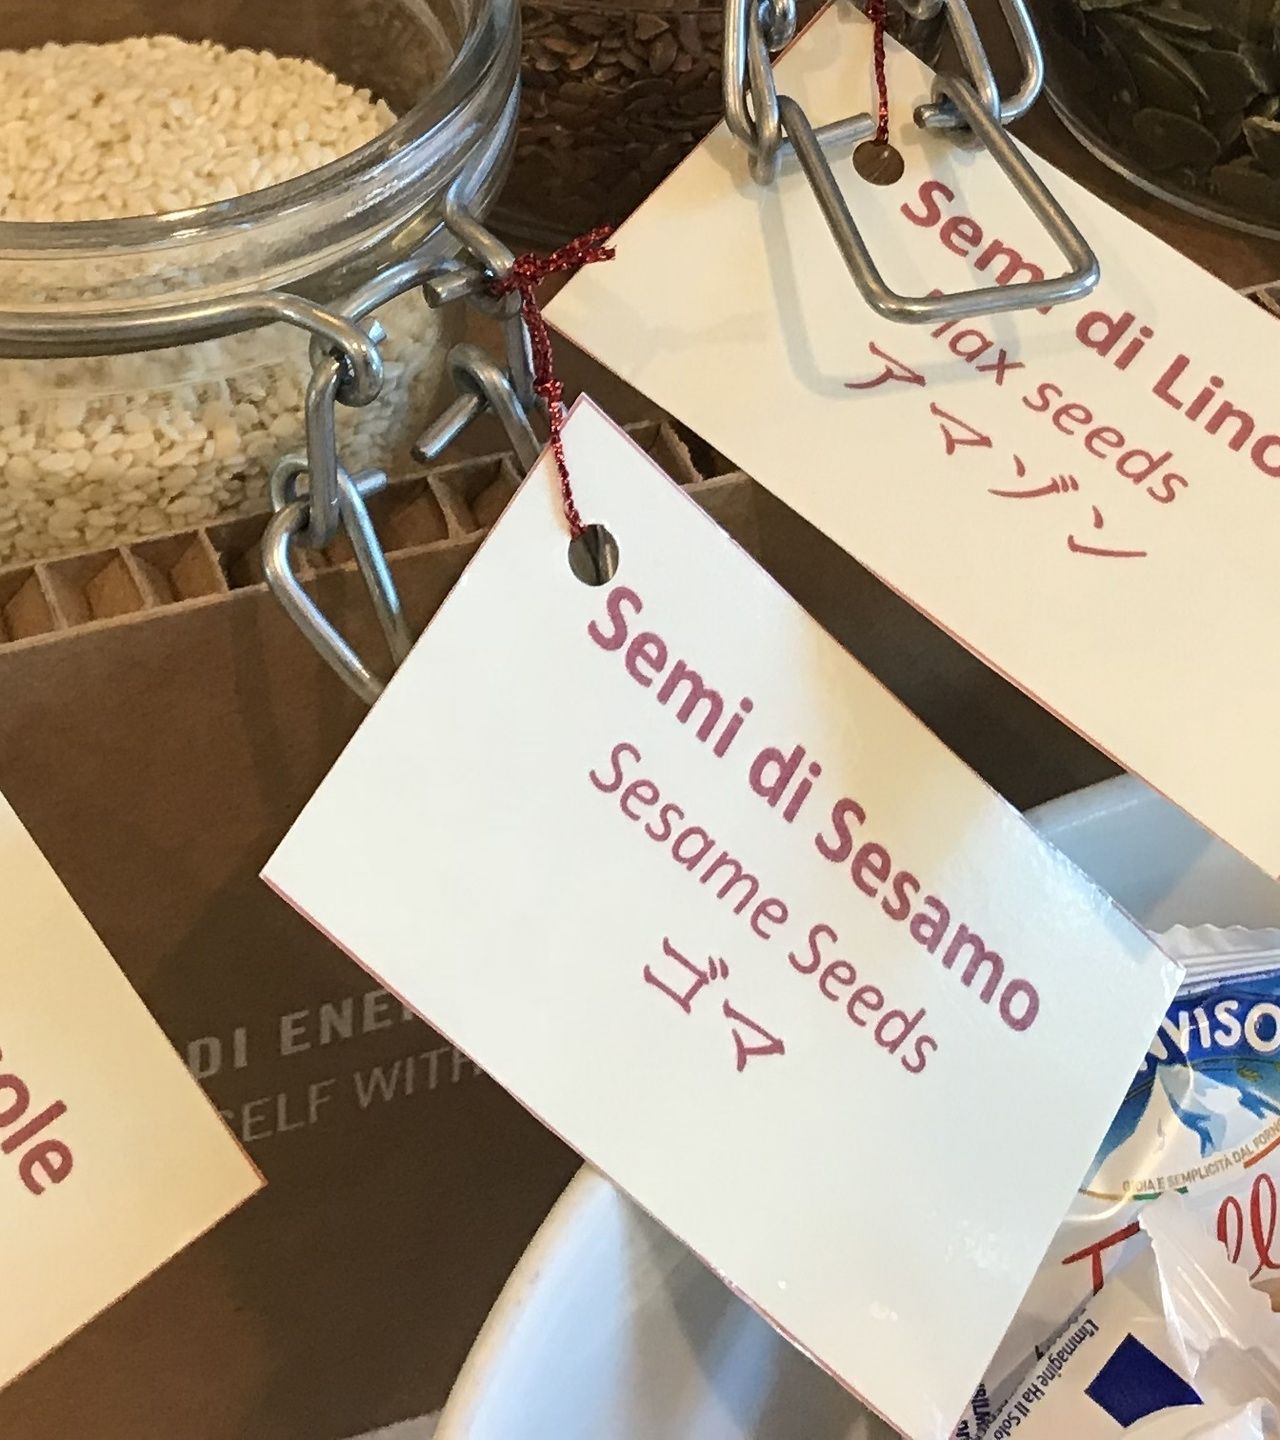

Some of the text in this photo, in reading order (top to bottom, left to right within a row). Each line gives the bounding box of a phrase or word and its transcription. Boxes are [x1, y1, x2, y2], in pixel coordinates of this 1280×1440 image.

[900, 178, 1072, 316] Sem
[1075, 309, 1154, 371] di
[844, 341, 1148, 558] アマゾン
[924, 288, 1189, 504] lax seeds
[586, 585, 1040, 1033] Semi di Sesamo
[588, 741, 938, 1074] Sesame Seeds
[280, 988, 417, 1056] ENE
[642, 936, 786, 1072] ゴマ
[220, 1078, 336, 1142] ELF
[1123, 1177, 1157, 1192] GOIA
[1232, 1145, 1254, 1164] DAL
[993, 1414, 1022, 1440] Solo
[1021, 1382, 1046, 1404] Ha
